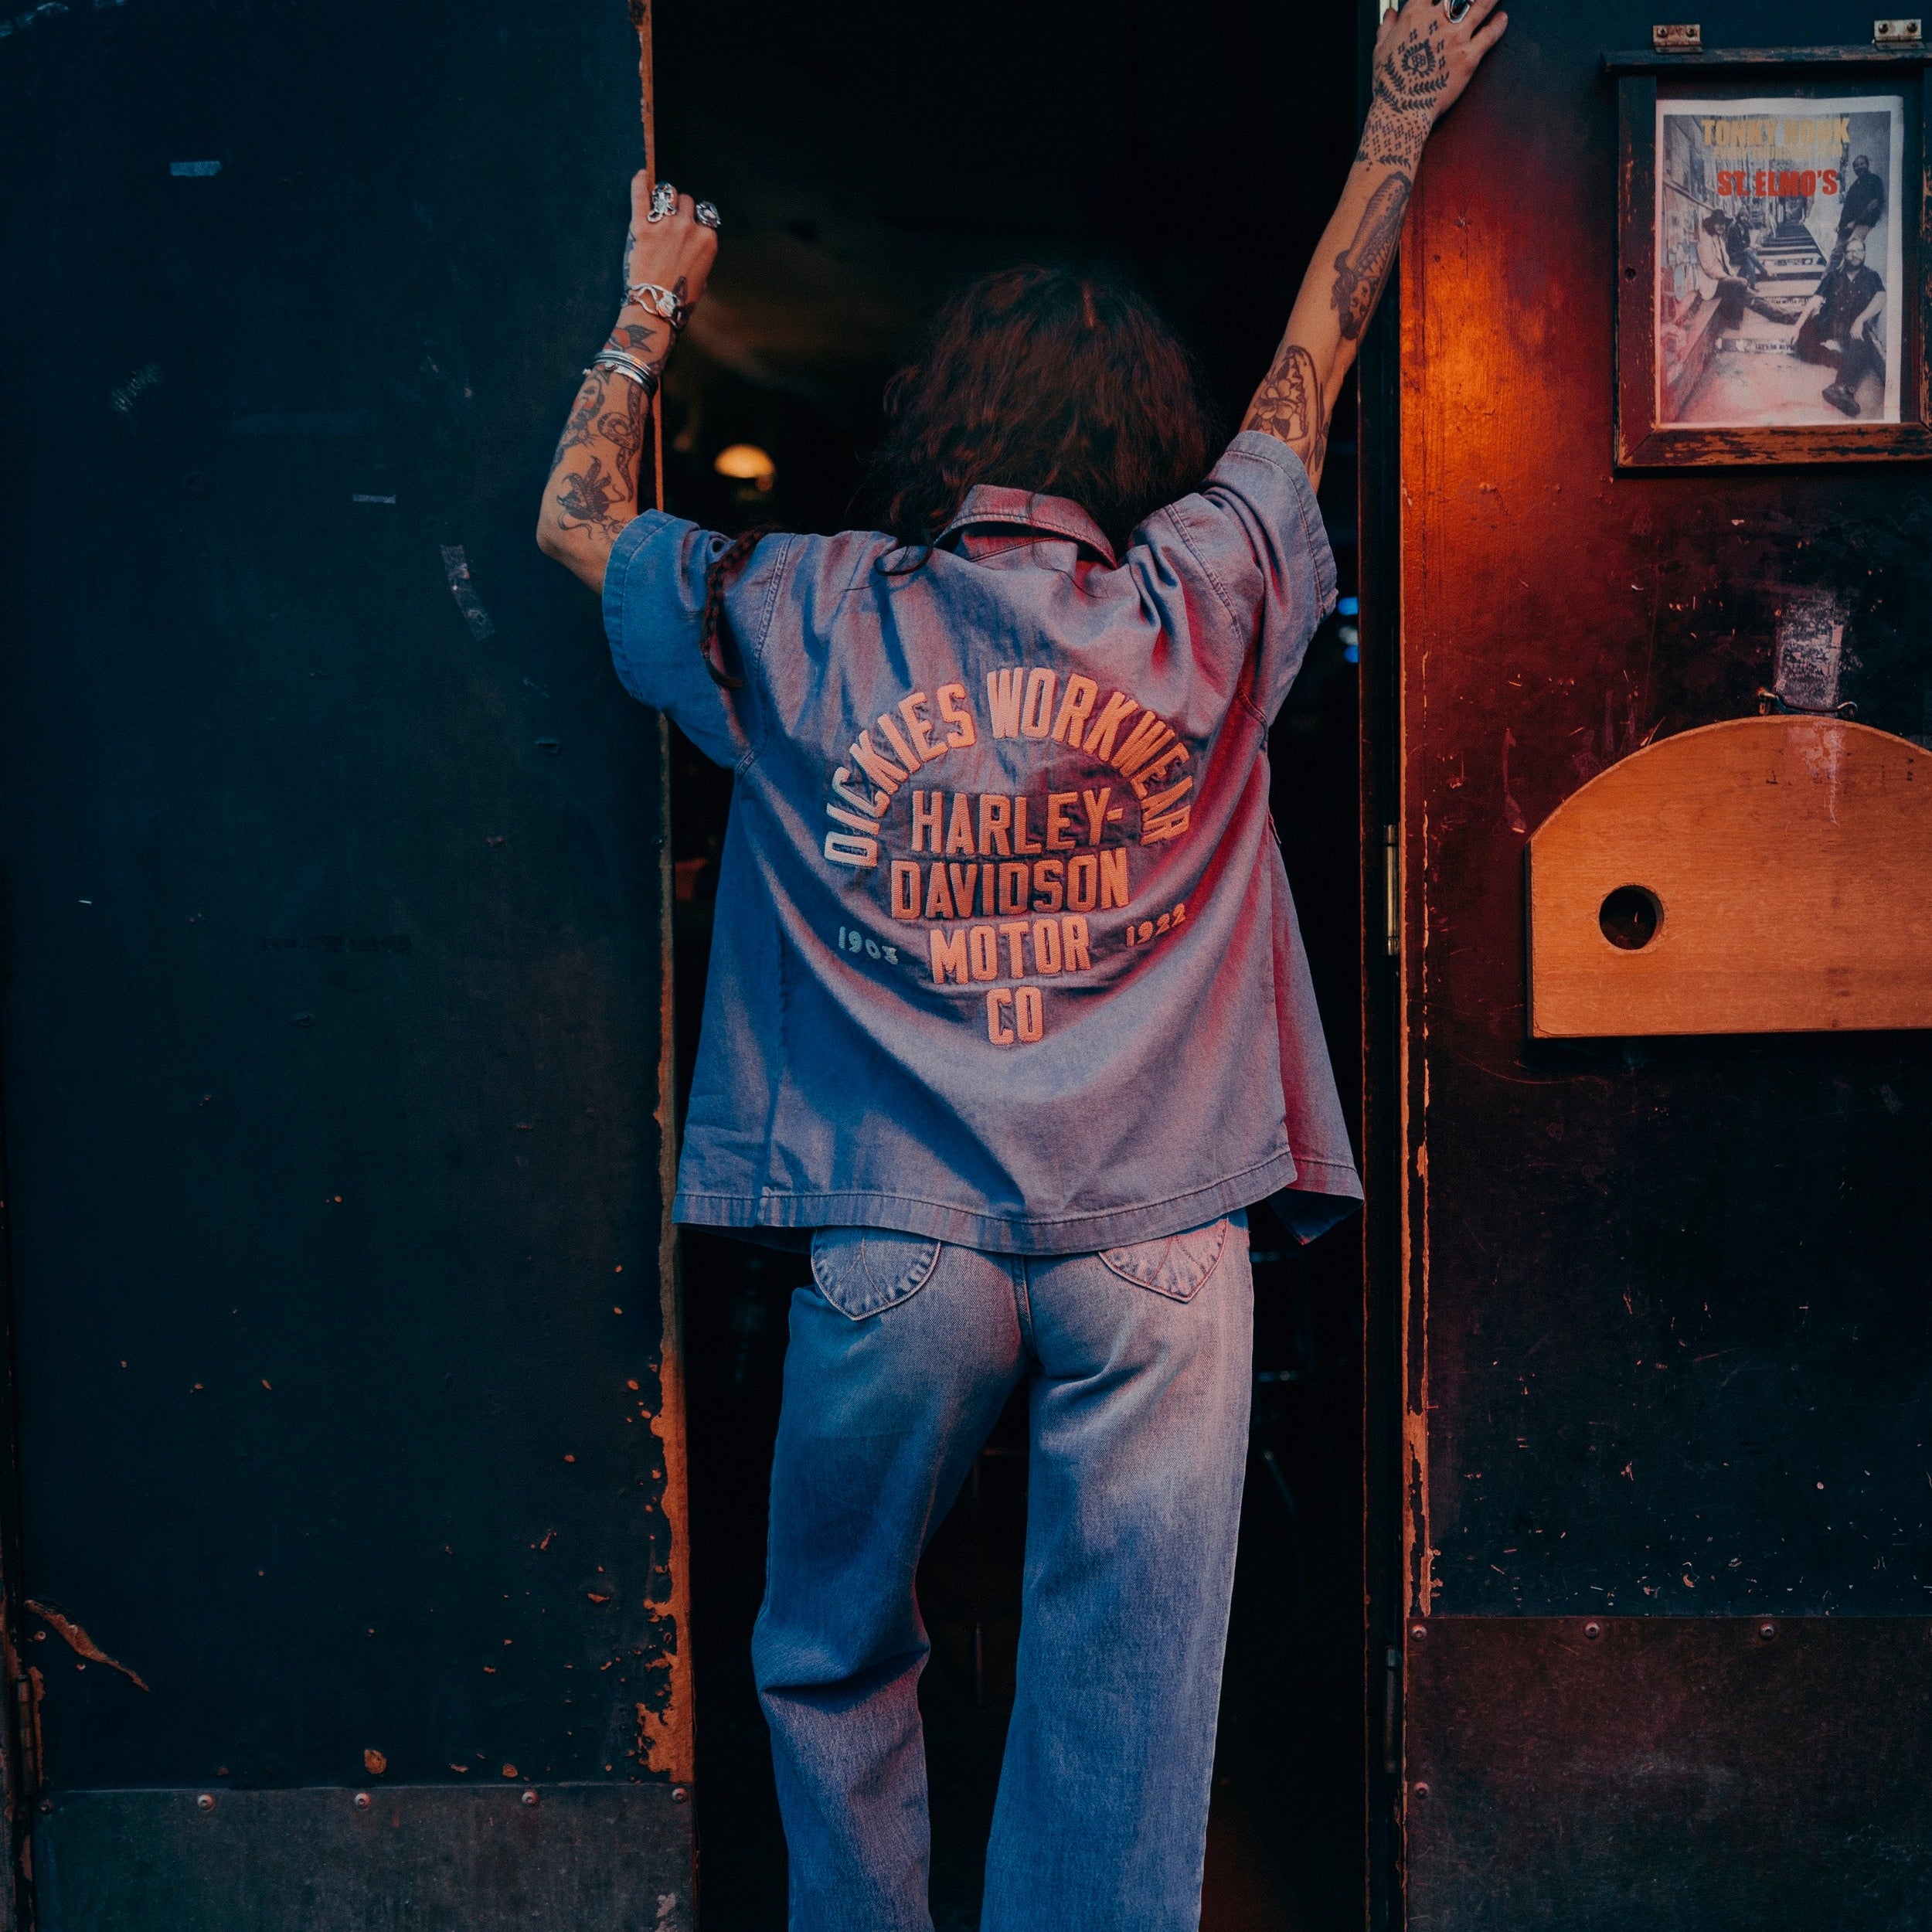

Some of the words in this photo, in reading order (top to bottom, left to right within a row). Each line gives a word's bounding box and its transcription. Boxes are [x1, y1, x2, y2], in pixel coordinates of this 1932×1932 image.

[1702, 119, 1778, 146] TONKY
[1784, 118, 1851, 144] HONK
[1717, 170, 1750, 196] ST.
[1755, 168, 1838, 197] ELMO'S
[825, 683, 977, 867] DICKIES
[987, 668, 1192, 846] WORKWEAR
[911, 787, 1124, 855] HARLEY-
[891, 848, 1130, 920] DAVIDSON
[838, 927, 898, 964] 1903
[930, 916, 1091, 985] MOTOR
[1126, 903, 1185, 947] 1922
[987, 986, 1044, 1045] CO
